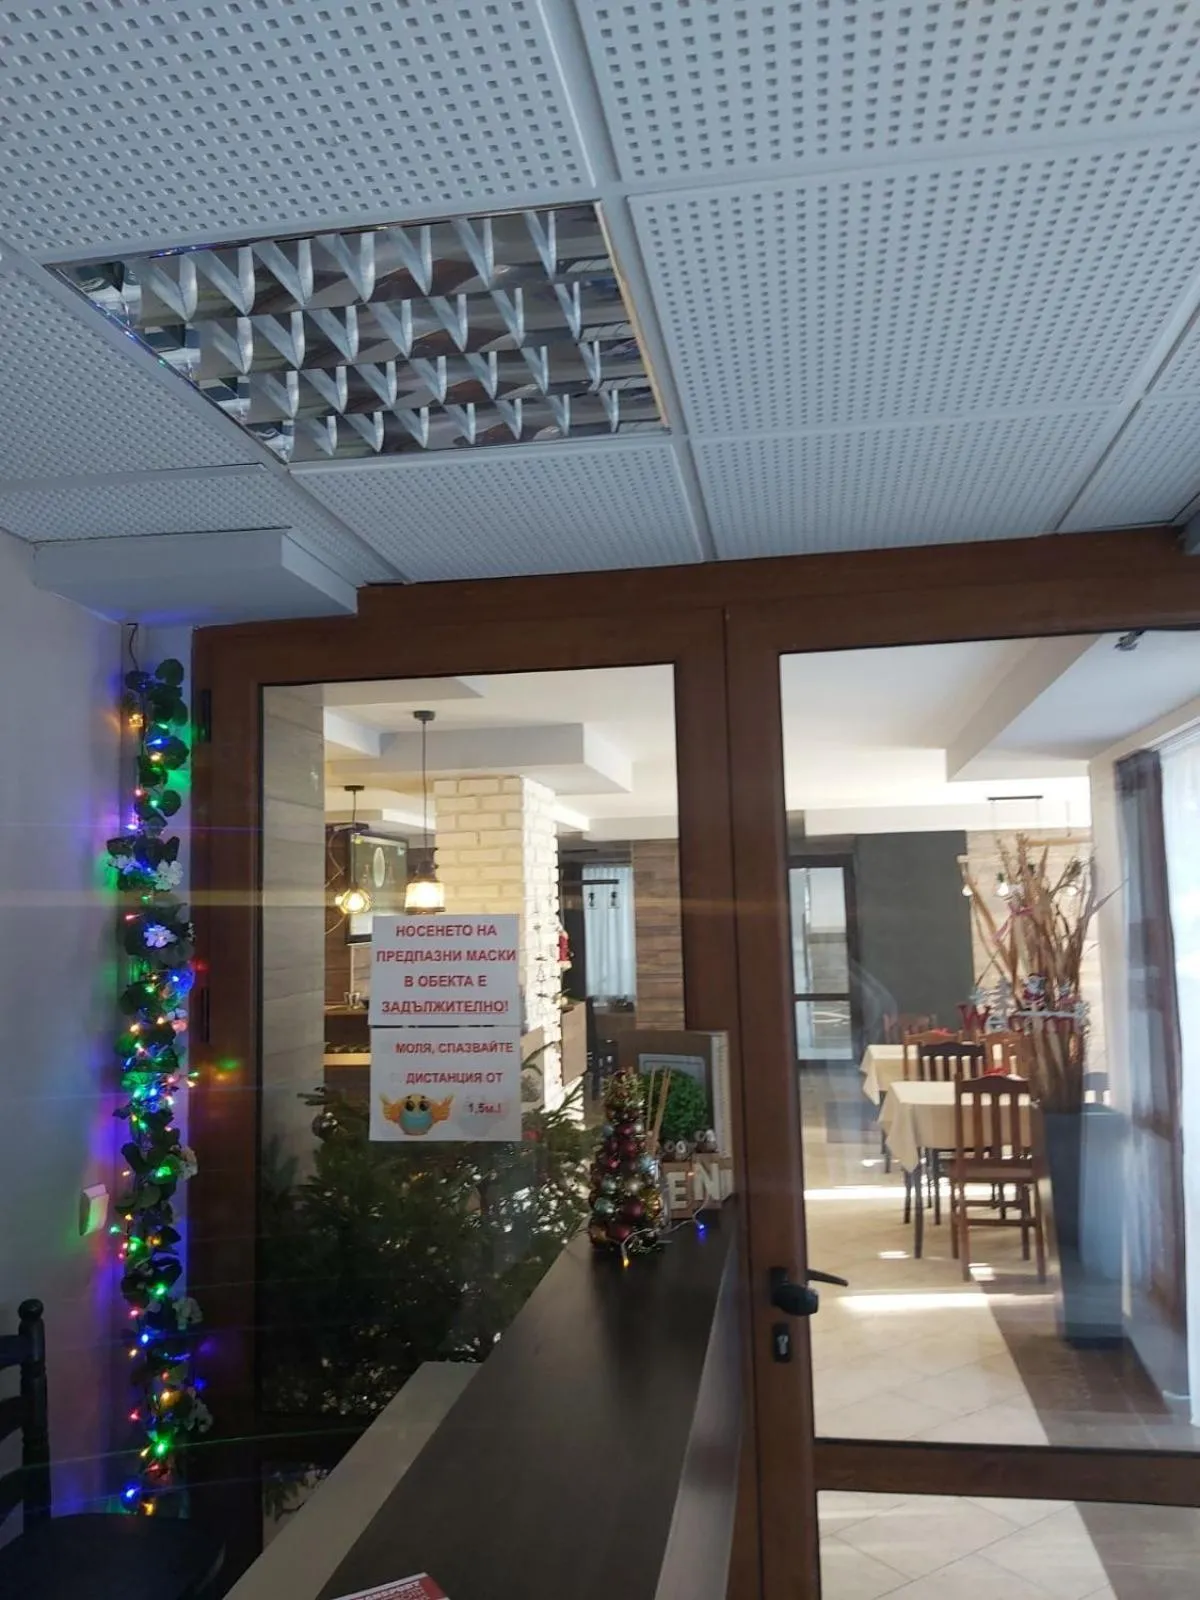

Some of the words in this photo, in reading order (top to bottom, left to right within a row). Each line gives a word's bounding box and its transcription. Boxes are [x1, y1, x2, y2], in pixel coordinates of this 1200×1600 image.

[395, 924, 473, 938] НОСЕНЕТО
[476, 924, 498, 937] НА
[376, 949, 465, 964] ПРЕДПАЗНИ
[466, 948, 517, 962] МАСКИ
[404, 975, 413, 988] В
[417, 975, 474, 988] ОБЕКТА
[478, 975, 488, 987] Е
[381, 1001, 509, 1014] ЗАДЪЛЖИТЕЛНО!
[395, 1041, 435, 1054] МОЛЯ,
[438, 1040, 514, 1053] СПАЗВАЙТЕ
[406, 1072, 483, 1086] ДИСТАНЦИЯ
[485, 1072, 504, 1085] ОТ
